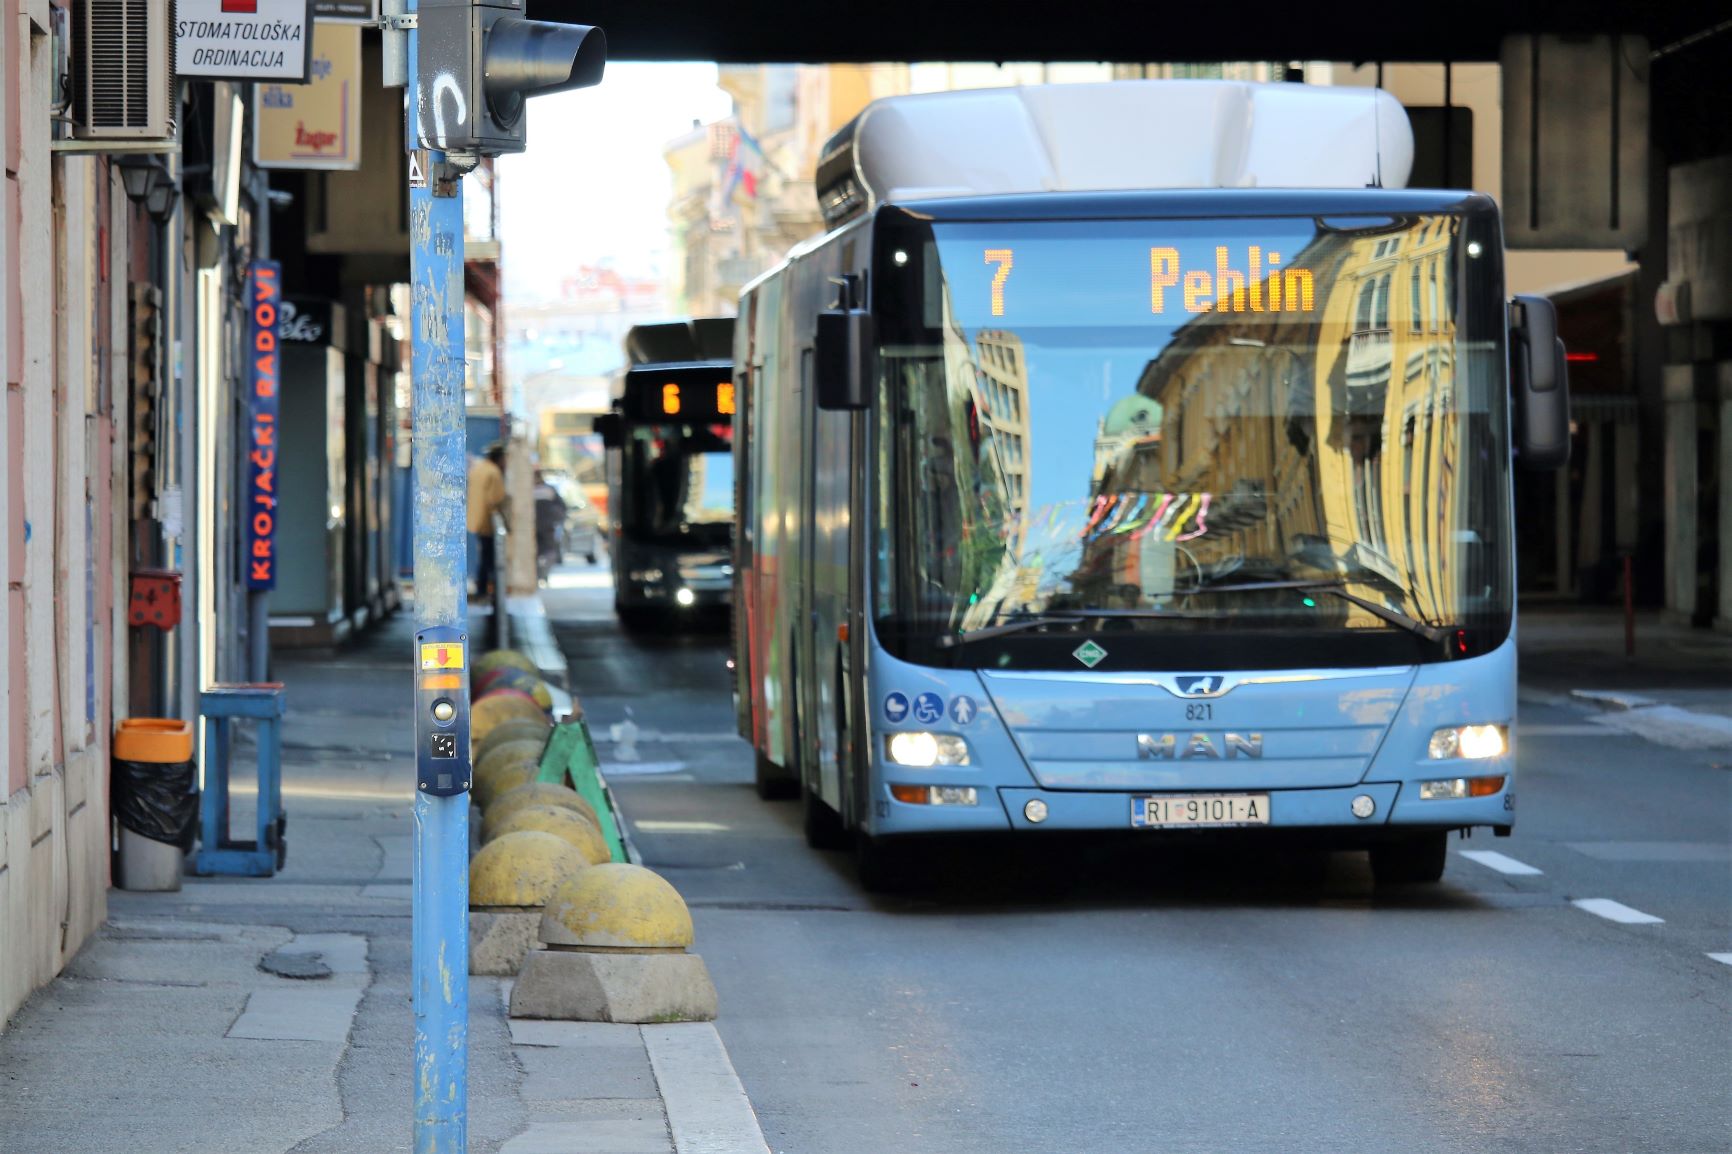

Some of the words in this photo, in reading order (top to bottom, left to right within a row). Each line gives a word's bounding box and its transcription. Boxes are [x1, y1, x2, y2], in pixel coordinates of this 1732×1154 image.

[176, 20, 301, 41] STOMATOLOŠKA
[193, 49, 284, 67] ORDINACIJA
[984, 249, 1013, 316] 7
[1150, 246, 1314, 314] Pehlin
[255, 269, 276, 397] RADOVI
[662, 383, 680, 415] 6
[250, 413, 275, 580] KROJAČKI
[1185, 703, 1213, 720] 821
[1137, 733, 1262, 759] MAN
[1148, 802, 1168, 821] RI
[1187, 800, 1259, 821] 9101-A
